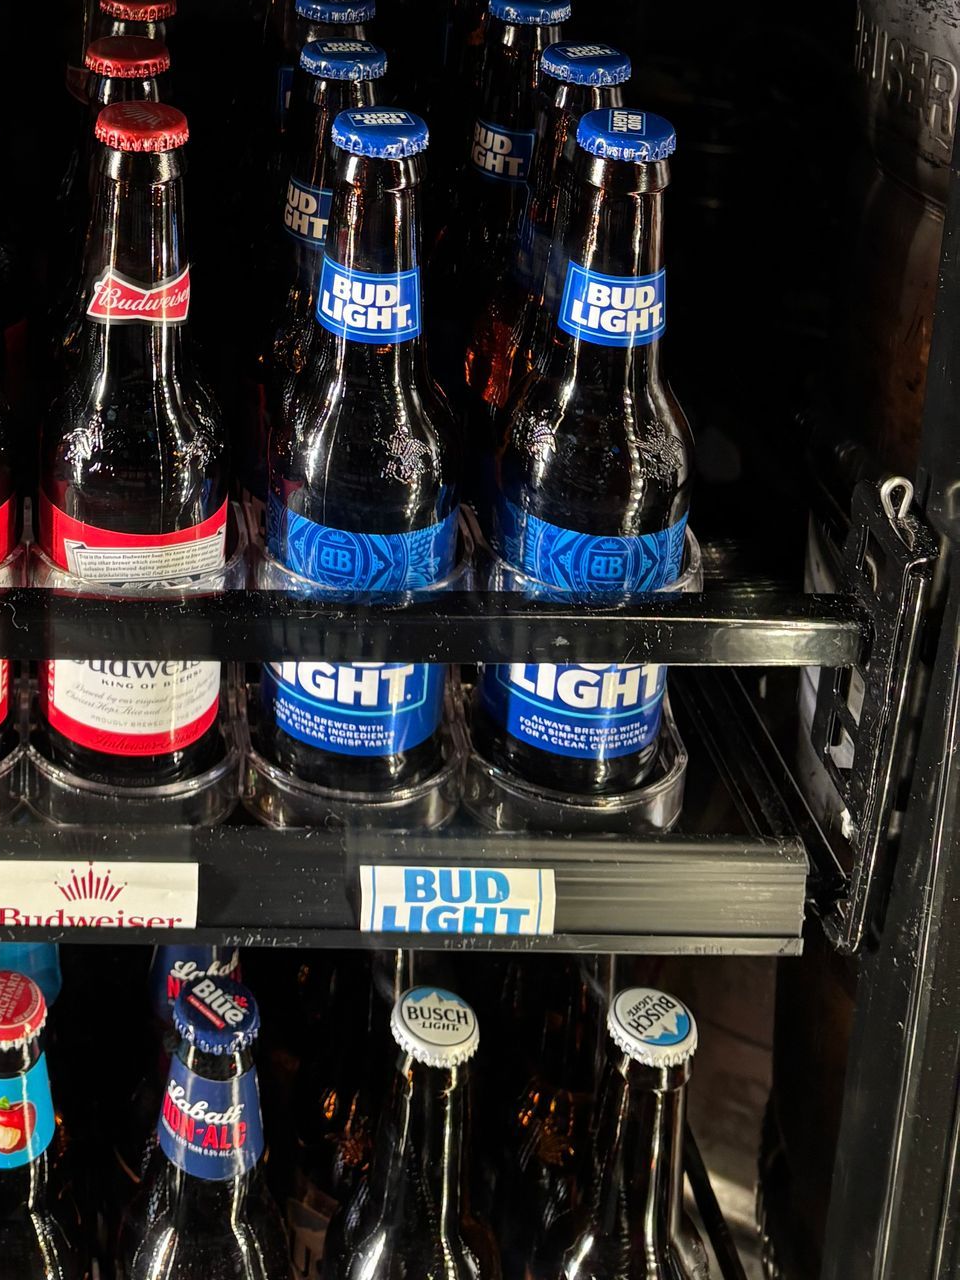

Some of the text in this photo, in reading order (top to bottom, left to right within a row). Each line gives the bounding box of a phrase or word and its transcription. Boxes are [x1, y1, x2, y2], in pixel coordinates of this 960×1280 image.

[613, 110, 628, 132] LIGHT
[627, 114, 642, 130] BUD
[94, 280, 189, 311] Budweiser
[331, 273, 399, 306] BUD
[586, 281, 655, 310] BUD
[320, 289, 412, 331] LIGHT
[569, 298, 663, 334] LIGHT
[101, 678, 157, 690] KING OF
[510, 663, 660, 709] LIGHT
[279, 697, 384, 732] ALWAYS BREWED WITH
[292, 712, 395, 739] SIMPLE INGREDIENTS
[519, 715, 648, 743] FOUR SIMPLE INGREDIENTS
[531, 714, 641, 736] ALWAYS BREWED WITH
[287, 718, 362, 747] A CLEAN, CRISP
[520, 724, 646, 751] FOR A CLEAN, TASTE
[404, 868, 511, 904] BUD
[382, 905, 531, 936] LIGHT
[191, 978, 244, 1026] Blue
[406, 1006, 469, 1025] BUSCH
[627, 994, 678, 1035] BUSCH
[167, 1079, 245, 1125] Labatt
